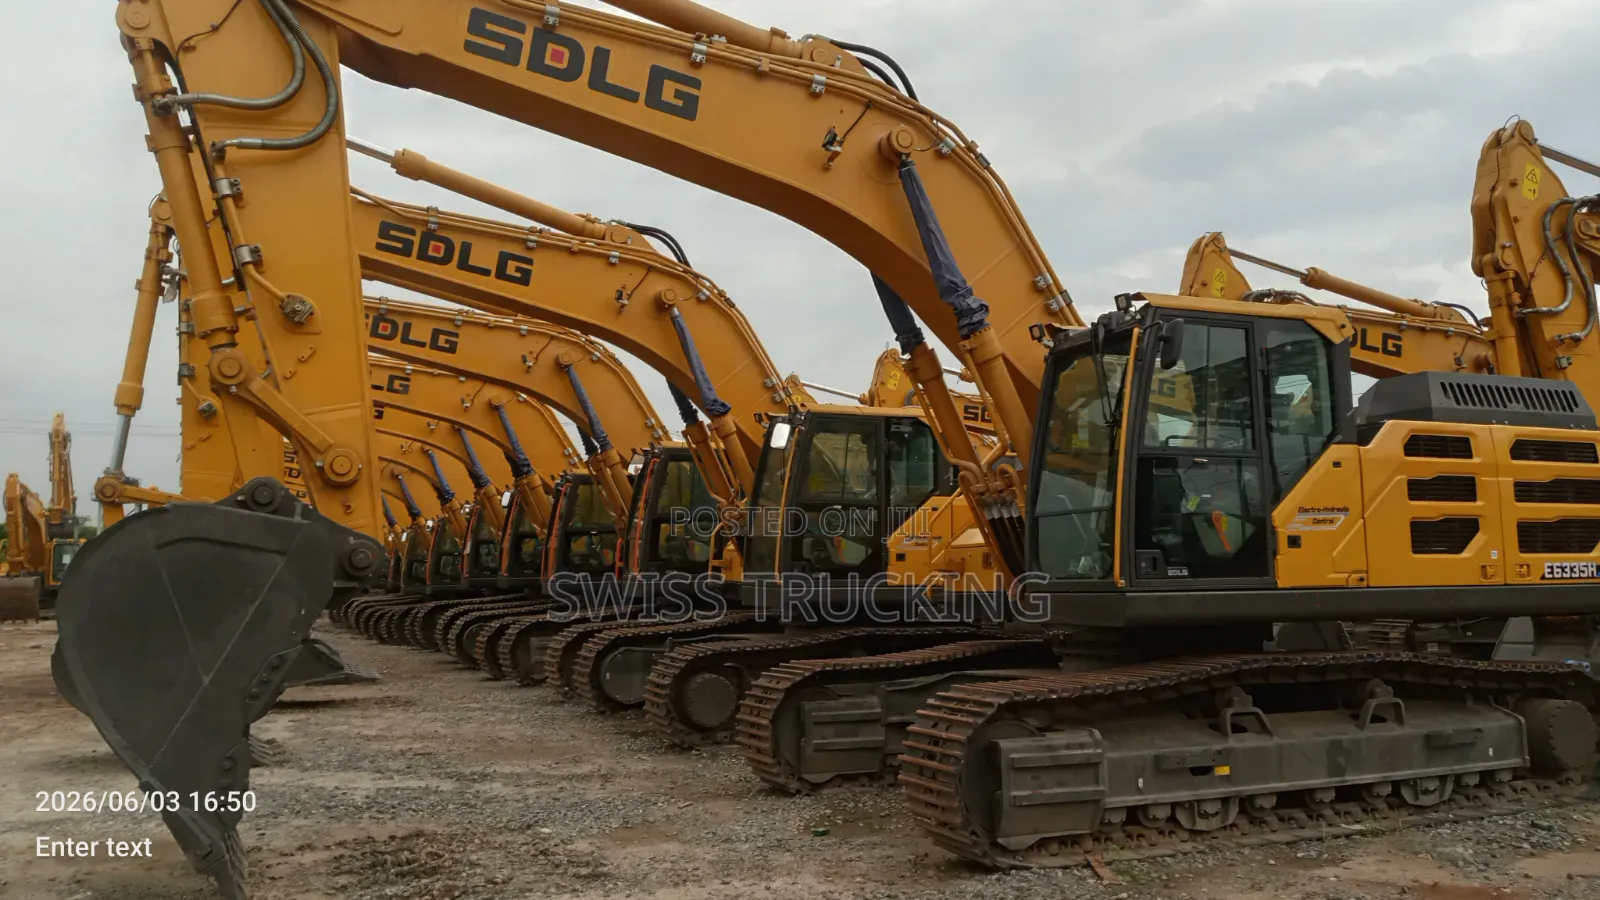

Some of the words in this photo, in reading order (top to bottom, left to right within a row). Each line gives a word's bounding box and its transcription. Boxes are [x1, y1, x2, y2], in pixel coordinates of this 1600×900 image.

[464, 7, 702, 121] SDLG
[375, 220, 534, 287] SDLG
[365, 313, 460, 354] DLG
[1350, 325, 1402, 358] LG
[1544, 562, 1597, 578] E6335H
